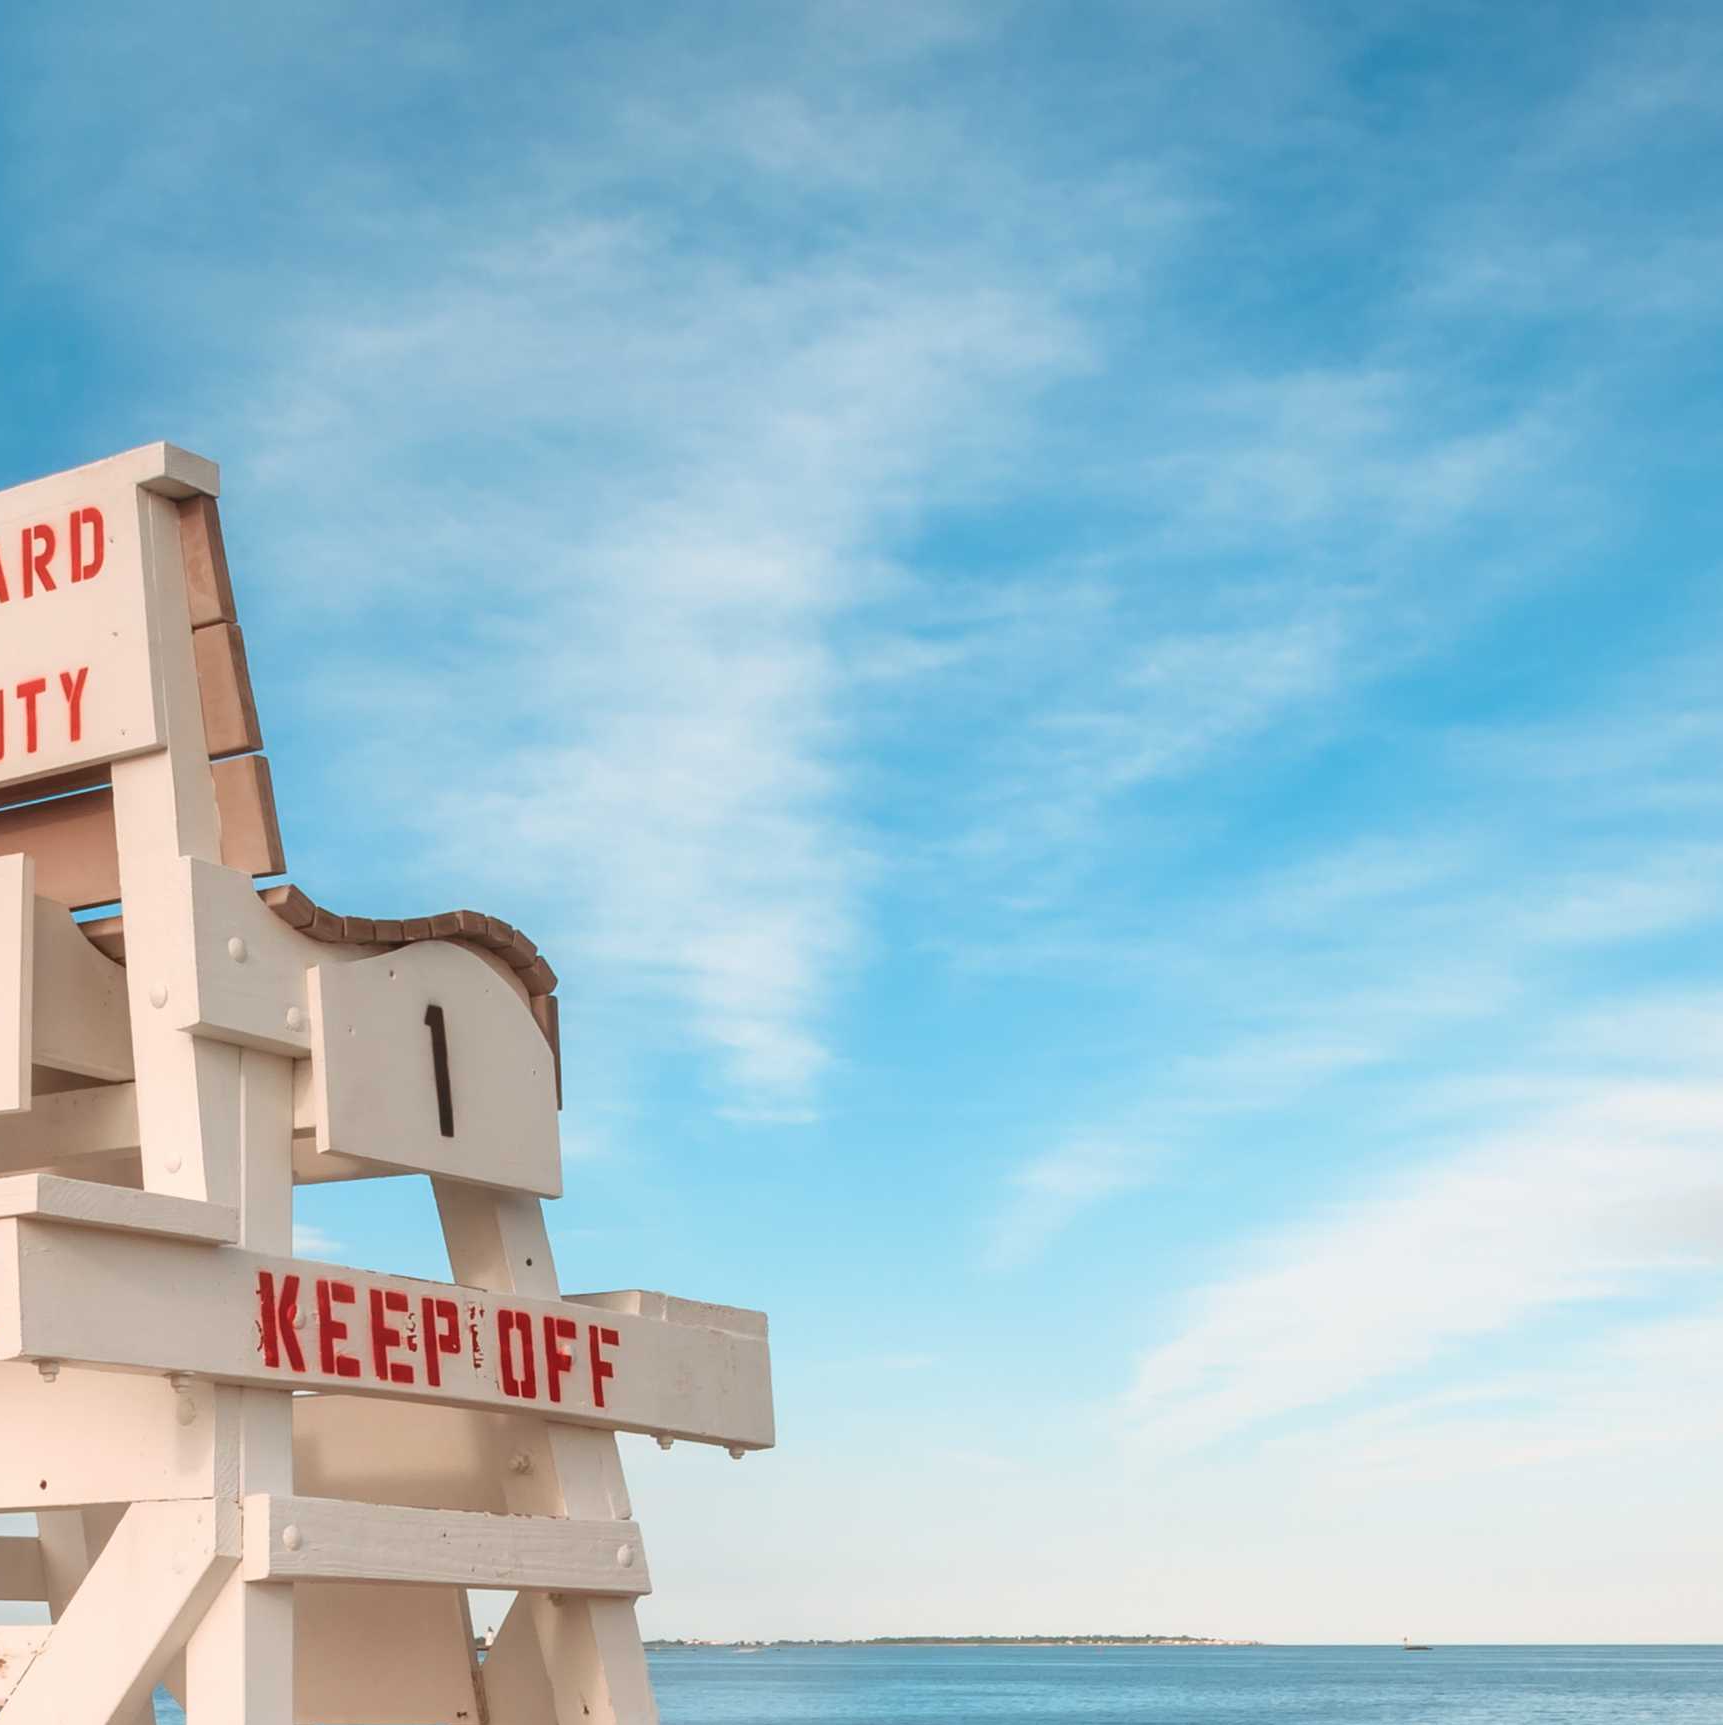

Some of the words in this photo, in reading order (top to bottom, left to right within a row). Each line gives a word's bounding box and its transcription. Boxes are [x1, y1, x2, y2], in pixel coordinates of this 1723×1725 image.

[424, 1003, 455, 1138] 1
[256, 1271, 462, 1387] KEEP
[496, 1308, 620, 1408] OFF
